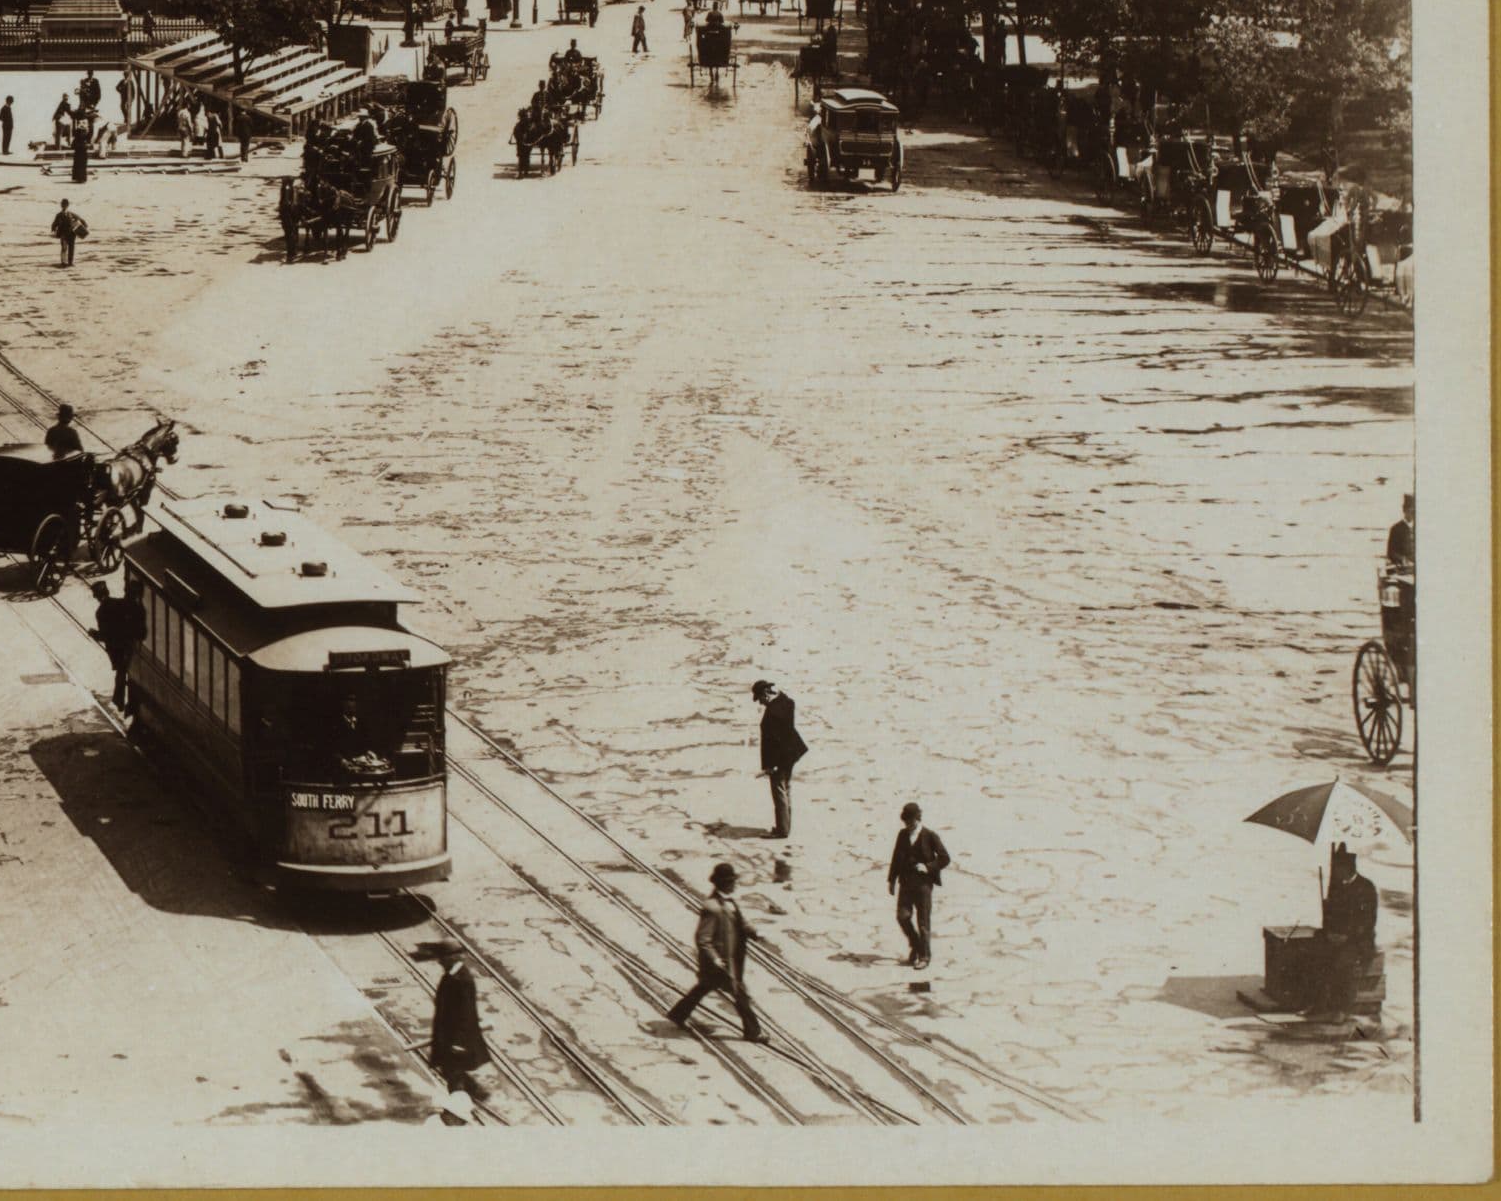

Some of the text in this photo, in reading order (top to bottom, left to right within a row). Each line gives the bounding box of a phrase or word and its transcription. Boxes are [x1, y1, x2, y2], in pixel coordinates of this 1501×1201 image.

[292, 792, 354, 810] SOUTH FERRY
[328, 809, 414, 840] 211
